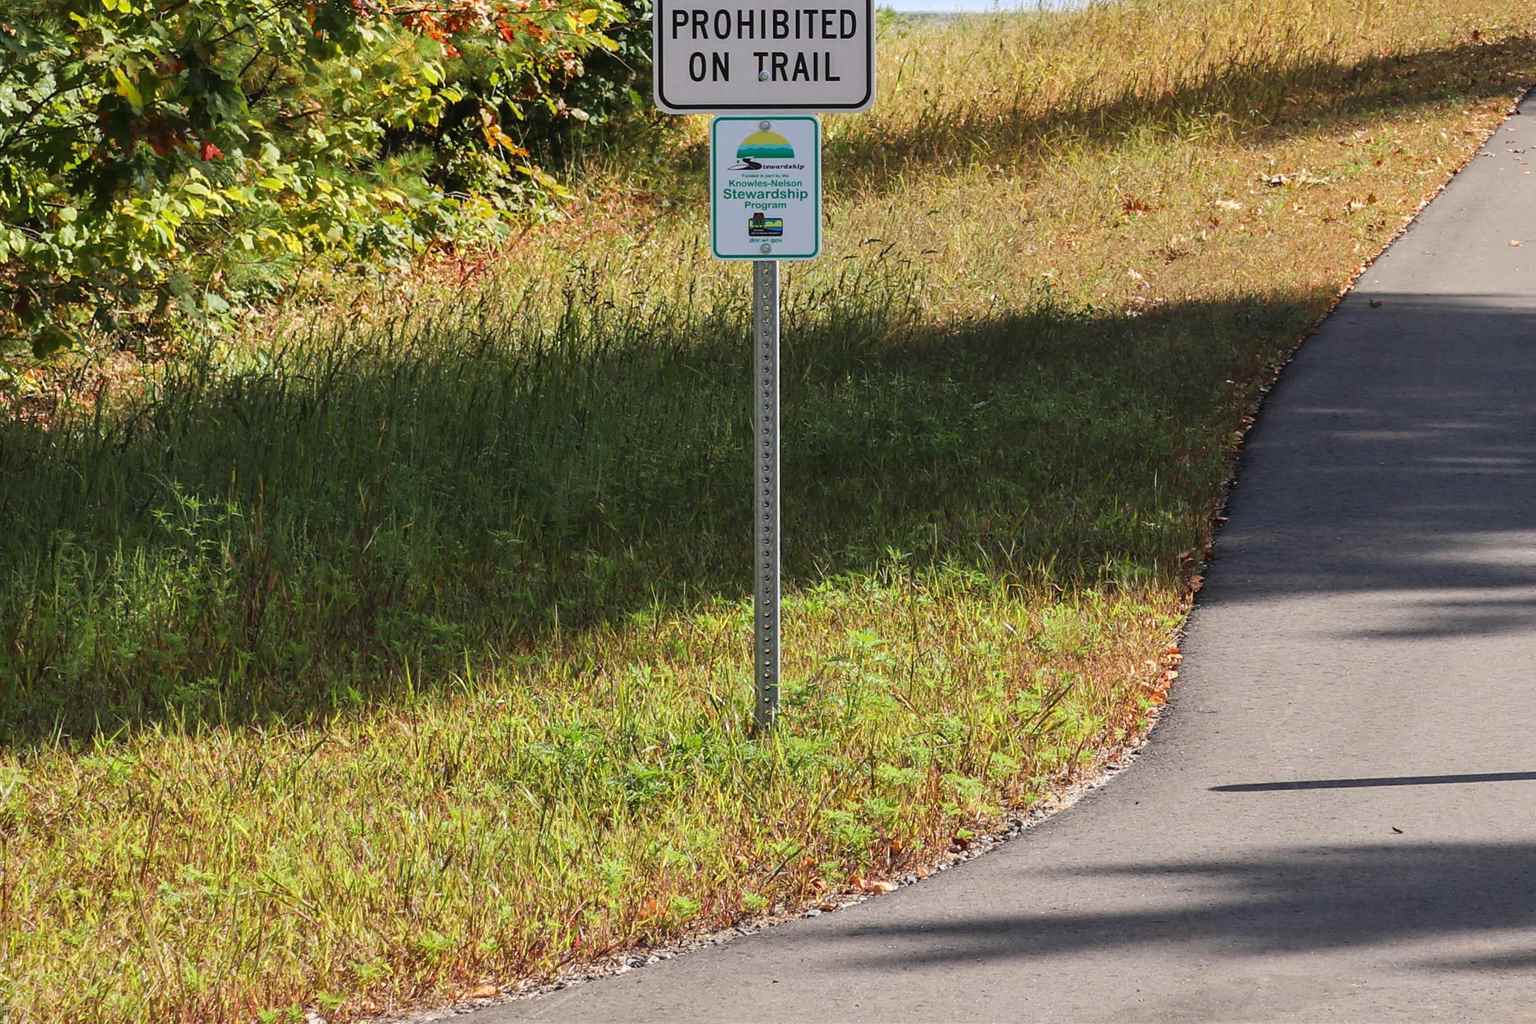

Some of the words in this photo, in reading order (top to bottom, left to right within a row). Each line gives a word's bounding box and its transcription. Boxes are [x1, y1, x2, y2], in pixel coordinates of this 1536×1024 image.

[672, 9, 857, 40] PROHIBITED
[689, 52, 730, 82] ON
[753, 52, 841, 82] TRAIL
[728, 179, 802, 188] Knowles-Nelson
[723, 188, 808, 201] Stewardship
[744, 201, 787, 210] Program
